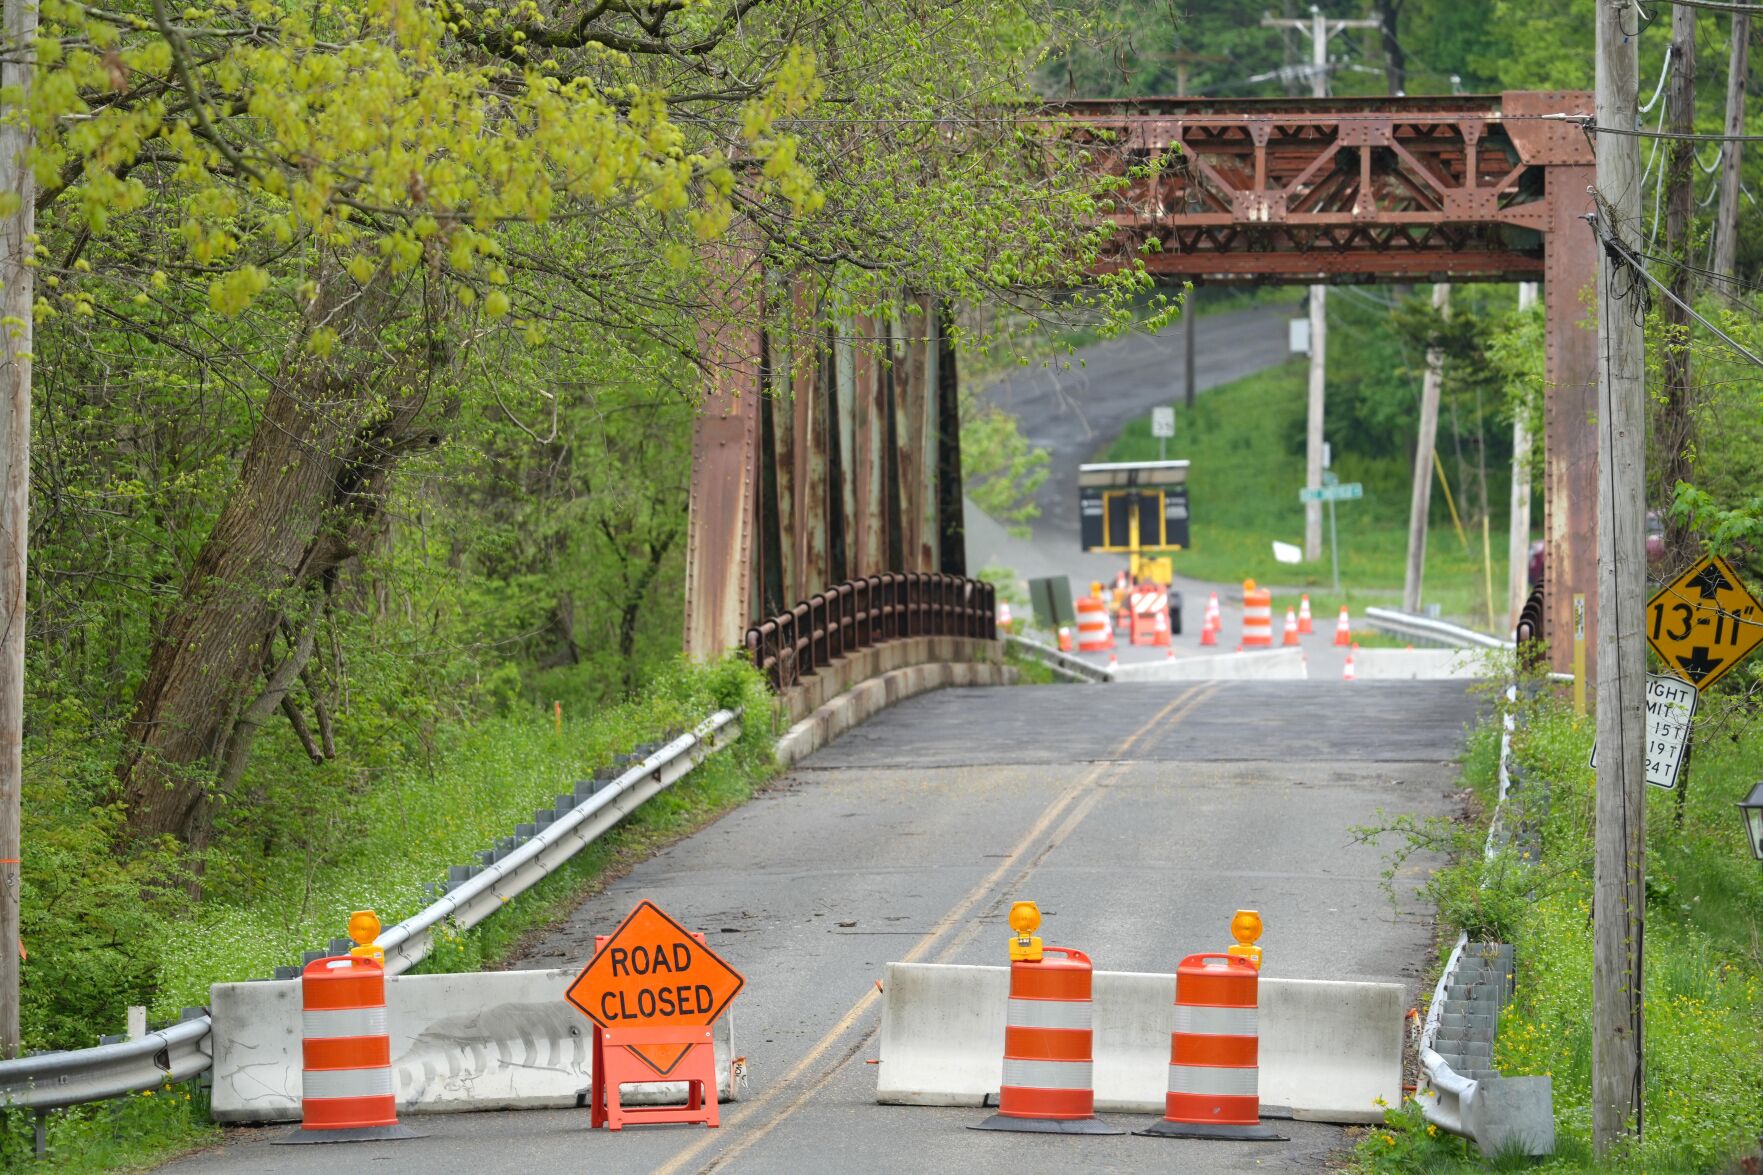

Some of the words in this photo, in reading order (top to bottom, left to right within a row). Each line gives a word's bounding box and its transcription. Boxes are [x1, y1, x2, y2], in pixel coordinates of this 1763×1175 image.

[1646, 681, 1688, 702] IGHT
[1646, 700, 1672, 718] MIT
[1655, 722, 1671, 737] 15
[1649, 741, 1666, 755] 19
[611, 943, 691, 976] ROAD
[601, 984, 713, 1020] CLOSED
